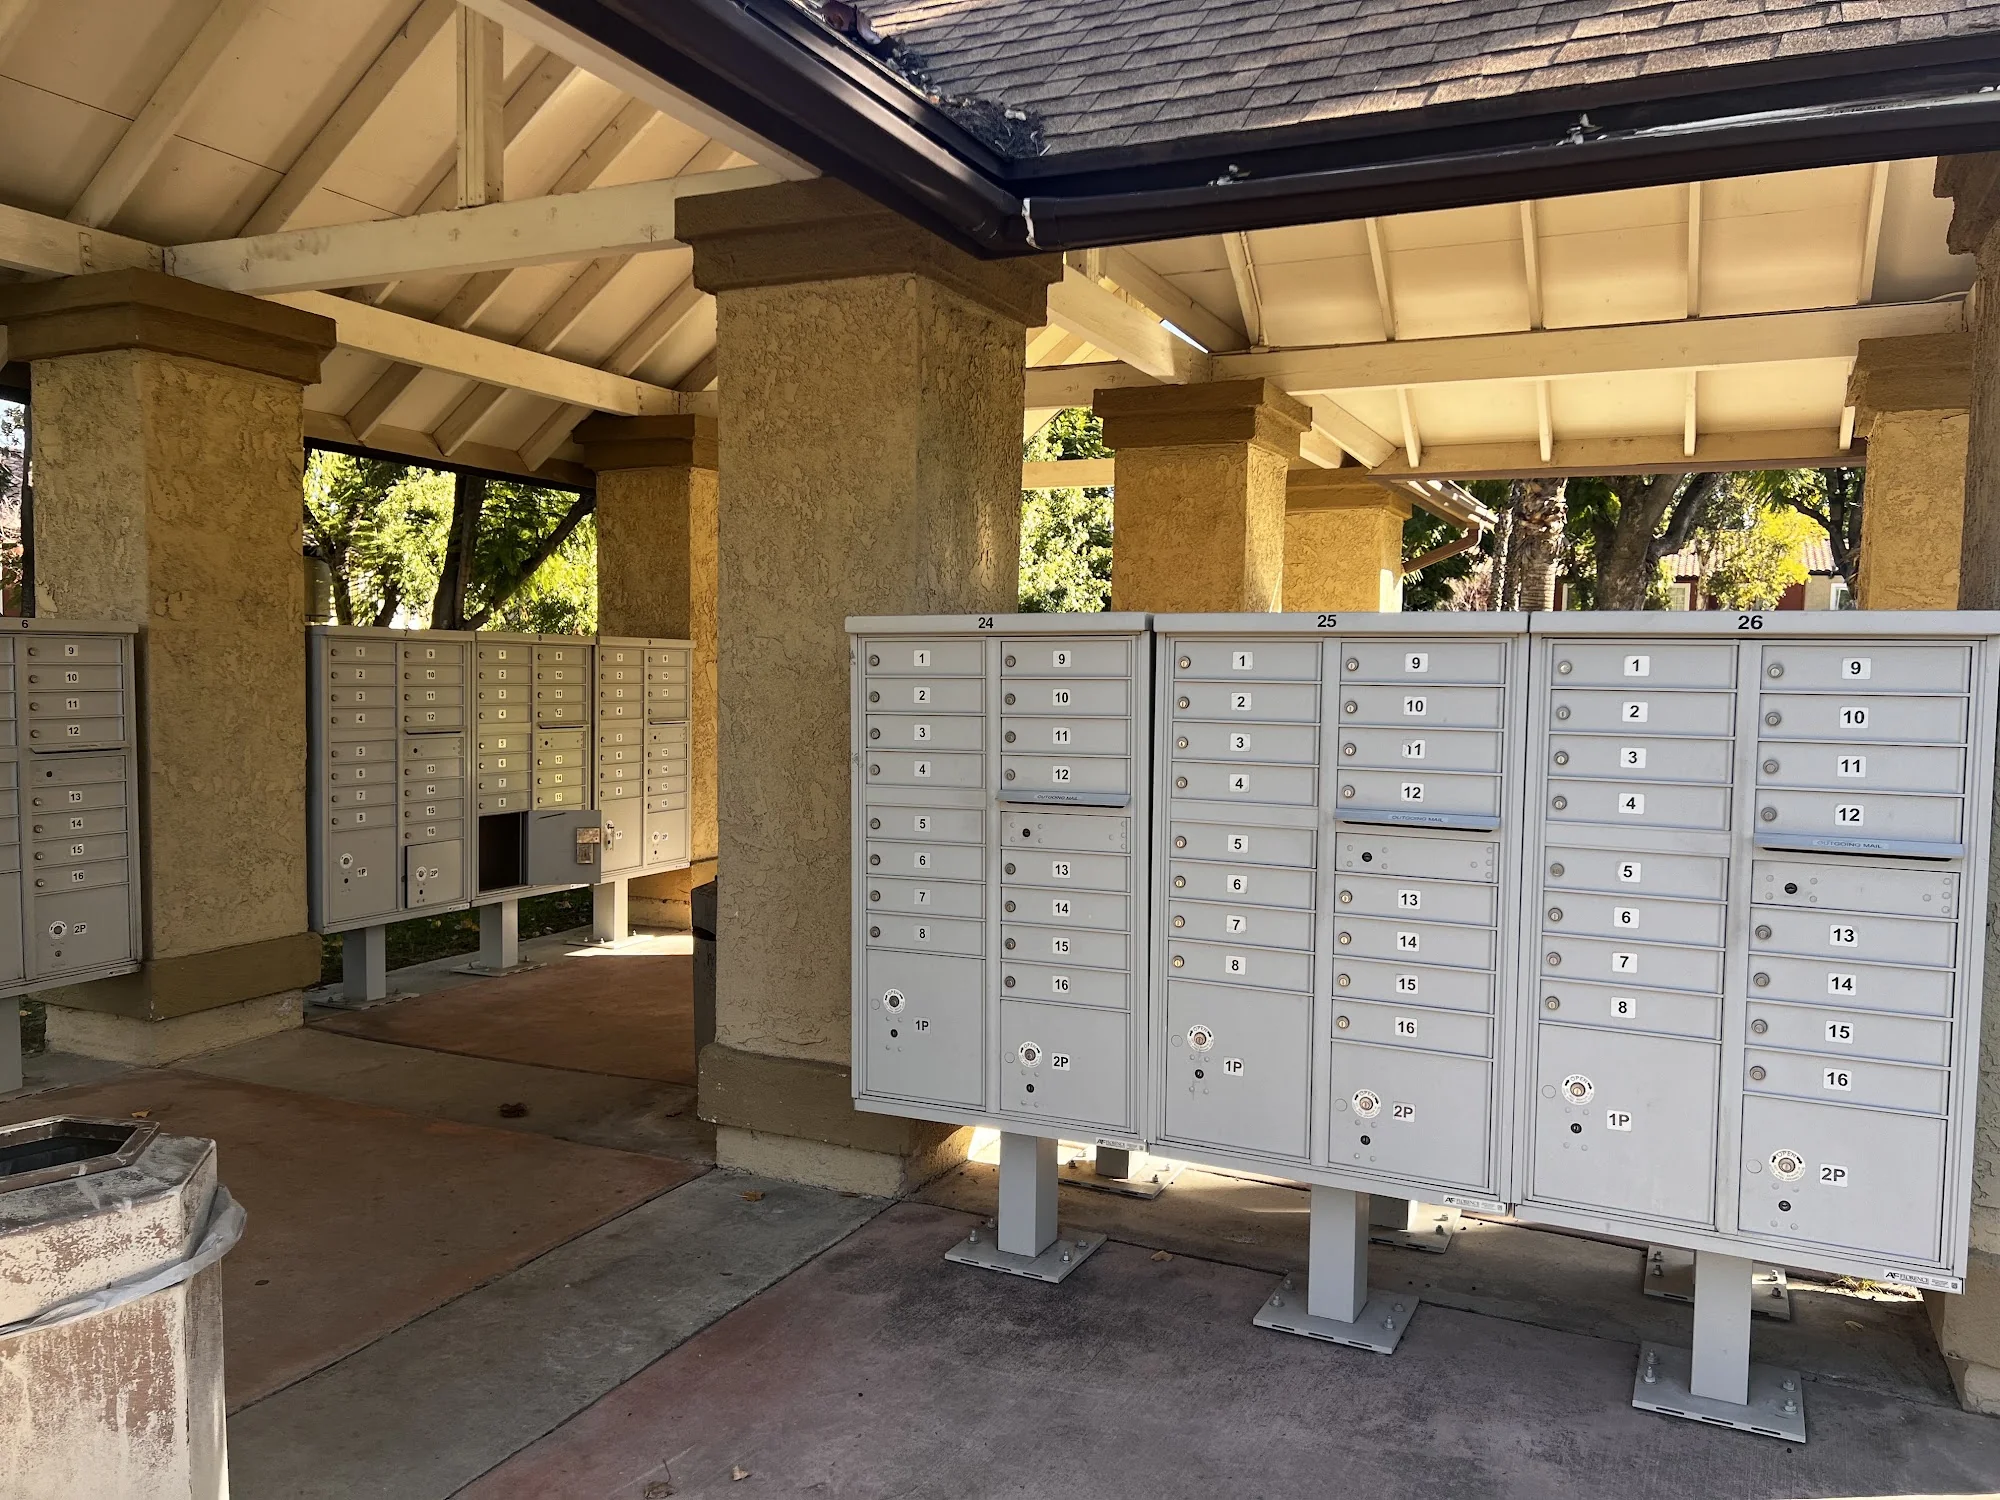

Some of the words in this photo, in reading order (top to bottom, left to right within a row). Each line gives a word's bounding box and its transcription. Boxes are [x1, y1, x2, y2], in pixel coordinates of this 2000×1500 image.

[21, 619, 29, 629] 6
[978, 616, 994, 629] 24
[1317, 614, 1337, 628] 25
[1737, 614, 1763, 630] 26
[68, 646, 74, 655] 9
[919, 653, 924, 664] 1
[1058, 653, 1066, 665] 9
[1239, 655, 1245, 667] 1
[1412, 657, 1421, 669] 9
[1632, 659, 1639, 672] 1
[1850, 661, 1861, 675] 9
[66, 673, 78, 682] 10
[919, 690, 926, 701] 2
[1055, 692, 1069, 703] 10
[67, 700, 77, 708] 11
[1237, 696, 1245, 708] 2
[1406, 700, 1424, 712] 10
[1629, 705, 1640, 718] 2
[1843, 710, 1865, 724] 10
[68, 726, 79, 735] 12
[919, 727, 926, 738] 3
[1055, 730, 1068, 742] 11
[1236, 736, 1244, 749] 3
[1628, 750, 1638, 764] 3
[919, 764, 926, 775] 4
[1841, 759, 1860, 773] 11
[1055, 768, 1069, 780] 12
[1235, 777, 1244, 789] 4
[70, 792, 81, 801] 13
[1404, 786, 1421, 799] 12
[1625, 796, 1636, 810] 4
[1838, 807, 1860, 822] 12
[71, 819, 82, 828] 14
[919, 818, 926, 829] 5
[72, 845, 83, 854] 15
[1234, 838, 1242, 850] 5
[919, 855, 926, 866] 6
[1055, 864, 1069, 876] 13
[1623, 865, 1633, 878] 5
[73, 872, 84, 881] 16
[1233, 878, 1241, 890] 6
[919, 891, 926, 902] 7
[1401, 893, 1418, 906] 13
[1055, 902, 1069, 914] 14
[1621, 911, 1631, 924] 6
[74, 924, 86, 934] 2P
[1232, 919, 1241, 931] 7
[919, 928, 926, 939] 8
[1833, 928, 1855, 943] 13
[1055, 940, 1069, 952] 15
[1400, 935, 1417, 948] 14
[1231, 959, 1239, 971] 8
[1619, 955, 1629, 968] 7
[1055, 978, 1069, 991] 16
[1398, 978, 1416, 991] 15
[1831, 976, 1853, 991] 14
[1618, 1000, 1628, 1014] 8
[915, 1020, 929, 1031] 1P
[1398, 1020, 1415, 1034] 16
[1828, 1024, 1850, 1039] 15
[1053, 1055, 1069, 1068] 2P
[1225, 1060, 1242, 1073] 1P
[1570, 1076, 1589, 1084] OPEN
[1827, 1072, 1848, 1087] 16
[1358, 1090, 1376, 1099] OPEN
[1393, 1105, 1413, 1118] 2P
[1608, 1113, 1630, 1127] 1P
[1821, 1167, 1846, 1182] 2P
